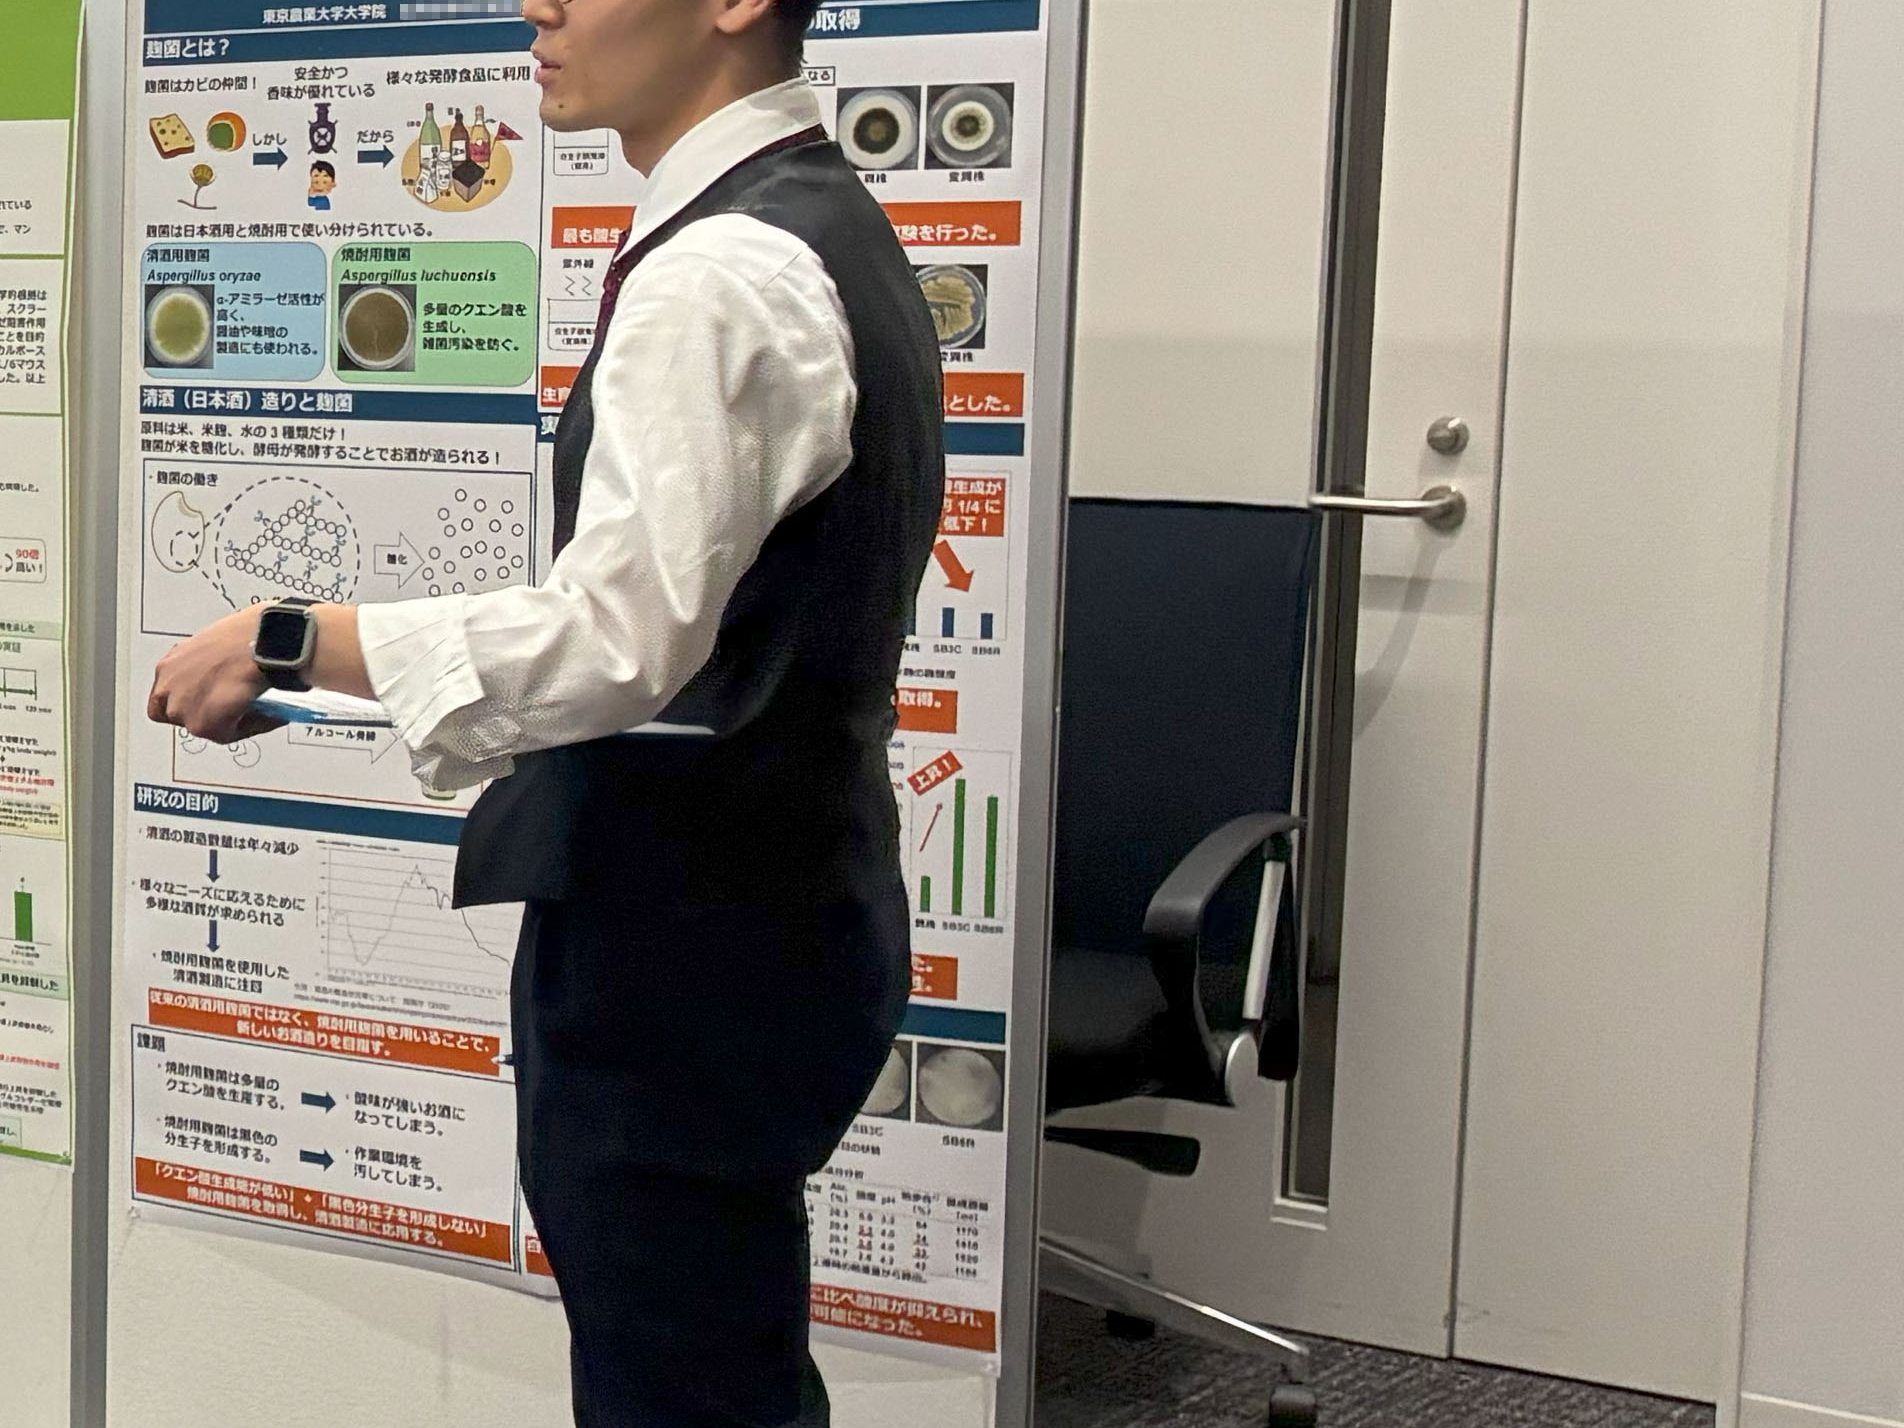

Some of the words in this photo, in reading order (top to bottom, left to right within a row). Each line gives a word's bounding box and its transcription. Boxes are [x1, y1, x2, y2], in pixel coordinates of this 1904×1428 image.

[262, 3, 387, 25] 東京農業大学大学院
[294, 66, 349, 82] 安全かつ
[385, 65, 532, 86] 様々な発酵食品に利用
[266, 83, 376, 101] 香味が優れている
[252, 131, 287, 147] しかし
[356, 129, 394, 145] だから
[147, 269, 215, 285] Aspergillus
[218, 270, 261, 285] oryzae
[340, 269, 417, 285] Aspergillus
[420, 268, 497, 284] luchuensis
[422, 301, 528, 318] 多量のクエン酸を
[422, 319, 468, 335] 生成し、
[216, 340, 319, 357] 製造にも使われる。
[945, 394, 1012, 412] とした。
[135, 786, 219, 815] 研究の目的
[354, 1110, 445, 1138] なってしまう。
[354, 1164, 444, 1193] 汚してしまう。
